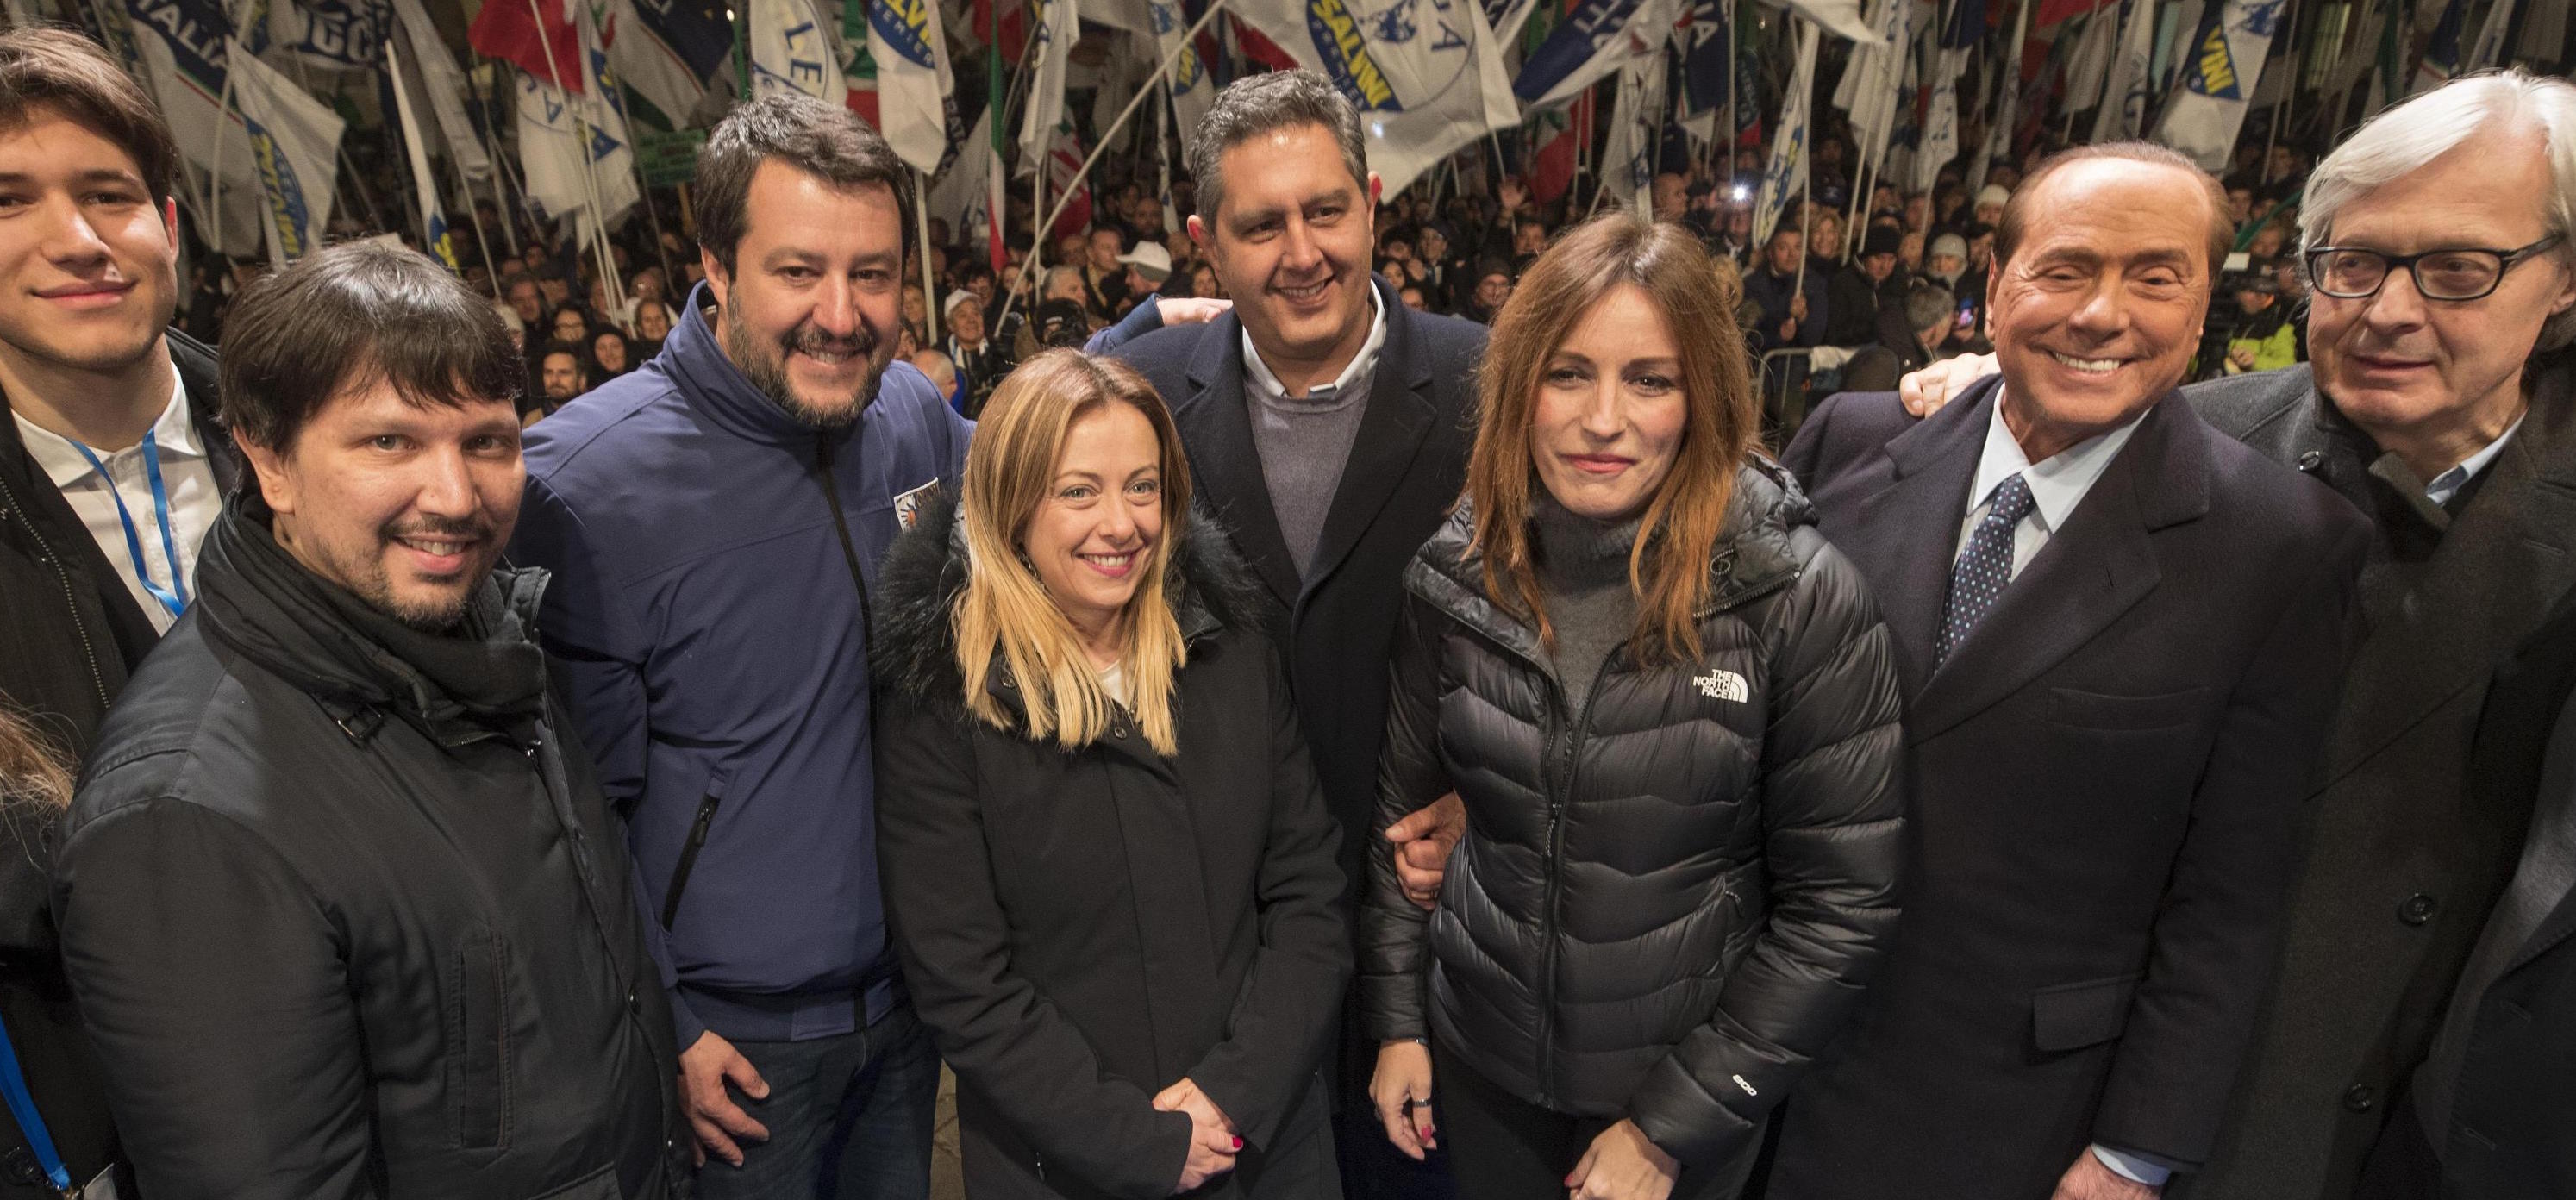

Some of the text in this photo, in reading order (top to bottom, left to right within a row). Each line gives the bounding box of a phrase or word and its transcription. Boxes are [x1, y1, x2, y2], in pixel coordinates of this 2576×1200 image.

[1312, 0, 1391, 109] SALVINI
[1692, 675, 1731, 693] NORTH
[1711, 668, 1733, 682] THE
[1701, 685, 1729, 700] FACE
[1732, 1074, 1757, 1097] 800
